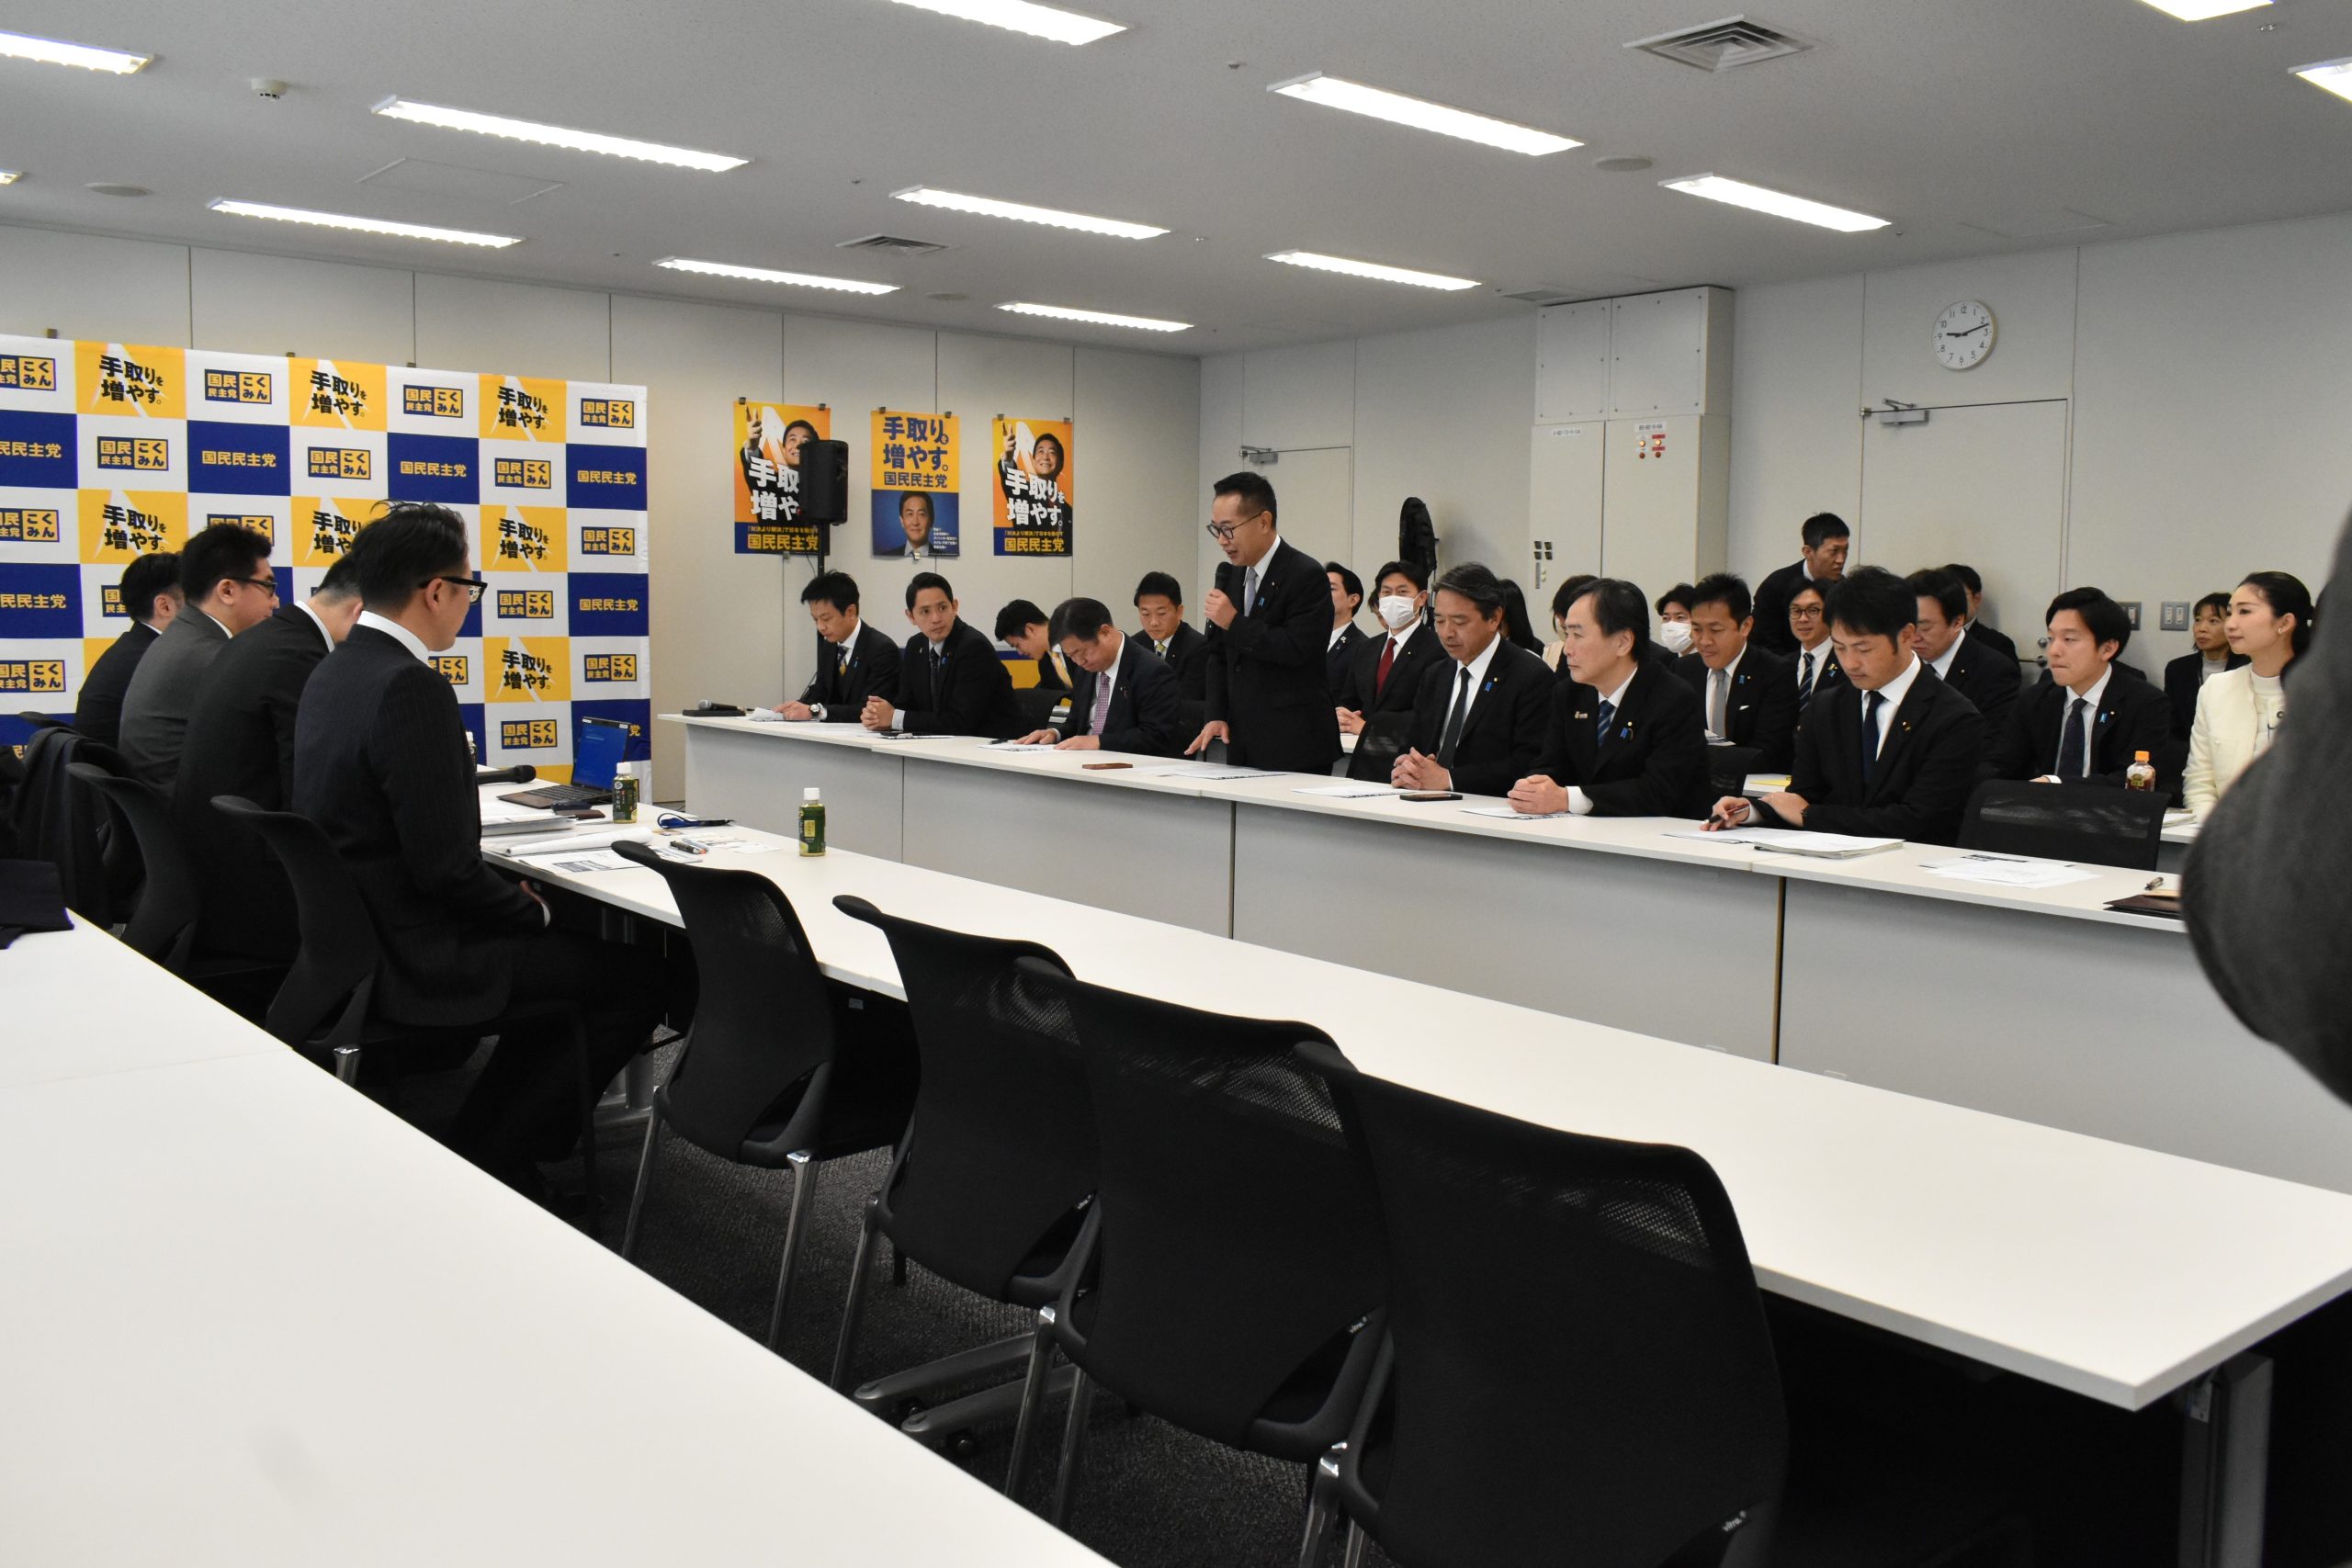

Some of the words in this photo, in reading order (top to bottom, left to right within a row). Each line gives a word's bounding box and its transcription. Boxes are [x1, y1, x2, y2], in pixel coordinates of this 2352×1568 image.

[0, 358, 16, 372] 民
[24, 361, 50, 373] こく
[99, 355, 164, 387] 手取りを
[23, 374, 51, 386] みん
[208, 373, 237, 387] 国民
[243, 376, 266, 388] こく
[310, 370, 367, 400] 手取りを
[101, 378, 162, 405] 増やす。
[208, 388, 237, 399] 民主党
[243, 388, 268, 400] みん
[406, 389, 432, 402] 国民
[437, 391, 458, 402] こく
[311, 393, 366, 418] 増やす。
[406, 401, 433, 412] 民主党
[497, 387, 548, 415] 手取りを
[436, 402, 459, 414] みん
[582, 401, 606, 414] 国民
[611, 403, 630, 414] こく
[498, 407, 548, 431] 増やす。
[582, 414, 607, 424] 民主党
[610, 414, 630, 425] みん
[100, 440, 131, 456] 国民
[138, 442, 162, 454] こく
[100, 456, 132, 466] 民主党
[137, 454, 164, 467] みん
[202, 450, 277, 468] 国民民主党
[311, 450, 337, 464] 国民
[345, 452, 365, 464] こく
[883, 443, 948, 471] 増やす。
[311, 464, 338, 475] 民主党
[344, 464, 367, 476] みん
[401, 461, 466, 477] 国民民主党
[497, 461, 522, 474] 国民
[526, 463, 547, 473] こく
[497, 474, 522, 485] 民主党
[526, 473, 547, 485] みん
[578, 470, 636, 485] 国民民主党
[884, 471, 947, 488] 国民民主党
[1005, 467, 1066, 504] 手取りを
[1006, 498, 1063, 526] 増やす。
[0, 512, 19, 526] 民
[27, 513, 52, 525] こく
[102, 504, 166, 533] 手取りを
[27, 526, 54, 539] みん
[499, 518, 548, 545] 手取りを
[582, 530, 606, 542] 国民
[611, 531, 629, 541] こく
[105, 528, 164, 551] 増やす。
[748, 534, 818, 550] 国民民主党
[1004, 537, 1064, 552] 国民民主党
[500, 539, 548, 560] 増やす。
[582, 542, 607, 552] 民主党
[611, 541, 631, 552] みん
[499, 593, 524, 605] 国民
[529, 593, 548, 604] こく
[500, 606, 525, 615] 民主党
[528, 604, 550, 615] みん
[580, 598, 639, 612] 国民民主党
[442, 660, 463, 670] こく
[502, 649, 552, 674] 手取りを
[586, 658, 609, 669] 国民
[614, 658, 631, 667] こく
[33, 664, 59, 675] こく
[587, 670, 610, 679] 民主党
[613, 668, 633, 678] みん
[33, 678, 61, 688] みん
[503, 671, 551, 690] 増やす。
[504, 724, 527, 736] 国民
[533, 723, 551, 733] こく
[503, 736, 528, 746] 民主党
[533, 733, 554, 744] みん
